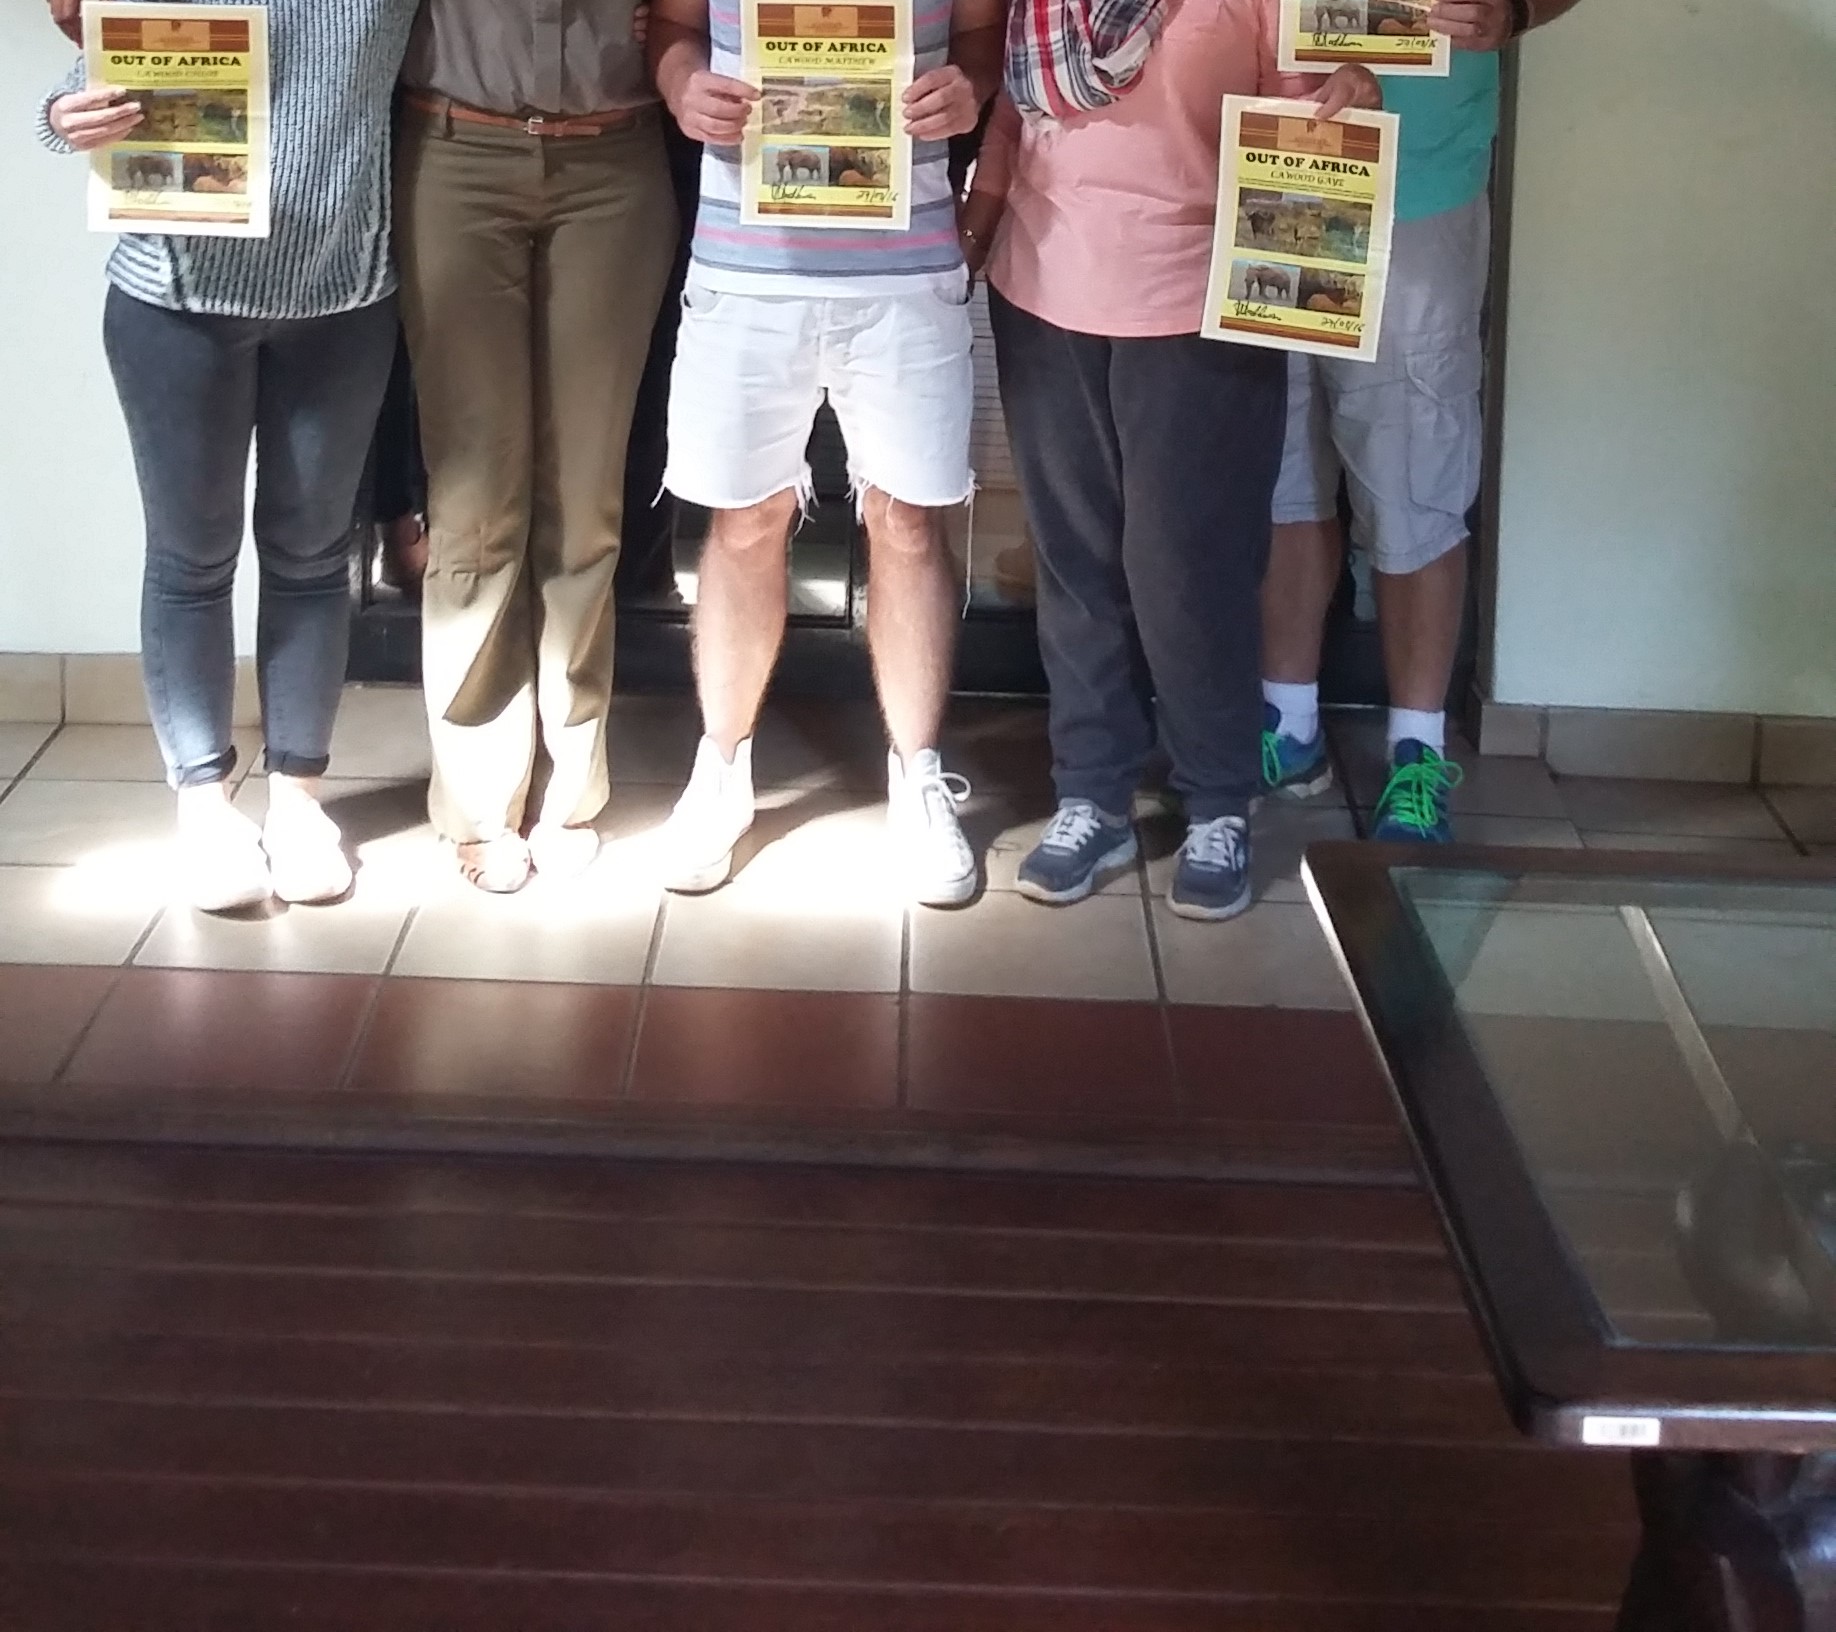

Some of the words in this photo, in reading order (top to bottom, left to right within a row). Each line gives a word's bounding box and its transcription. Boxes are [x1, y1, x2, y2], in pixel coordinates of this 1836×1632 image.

[765, 41, 799, 53] OUT
[803, 42, 824, 53] OF
[827, 42, 888, 54] AFRICA
[110, 55, 146, 66] OUT
[150, 56, 173, 67] OF
[177, 56, 241, 68] AFRICA
[1245, 152, 1280, 166] OUT
[1283, 156, 1306, 169] OF
[1308, 160, 1371, 177] AFRICA
